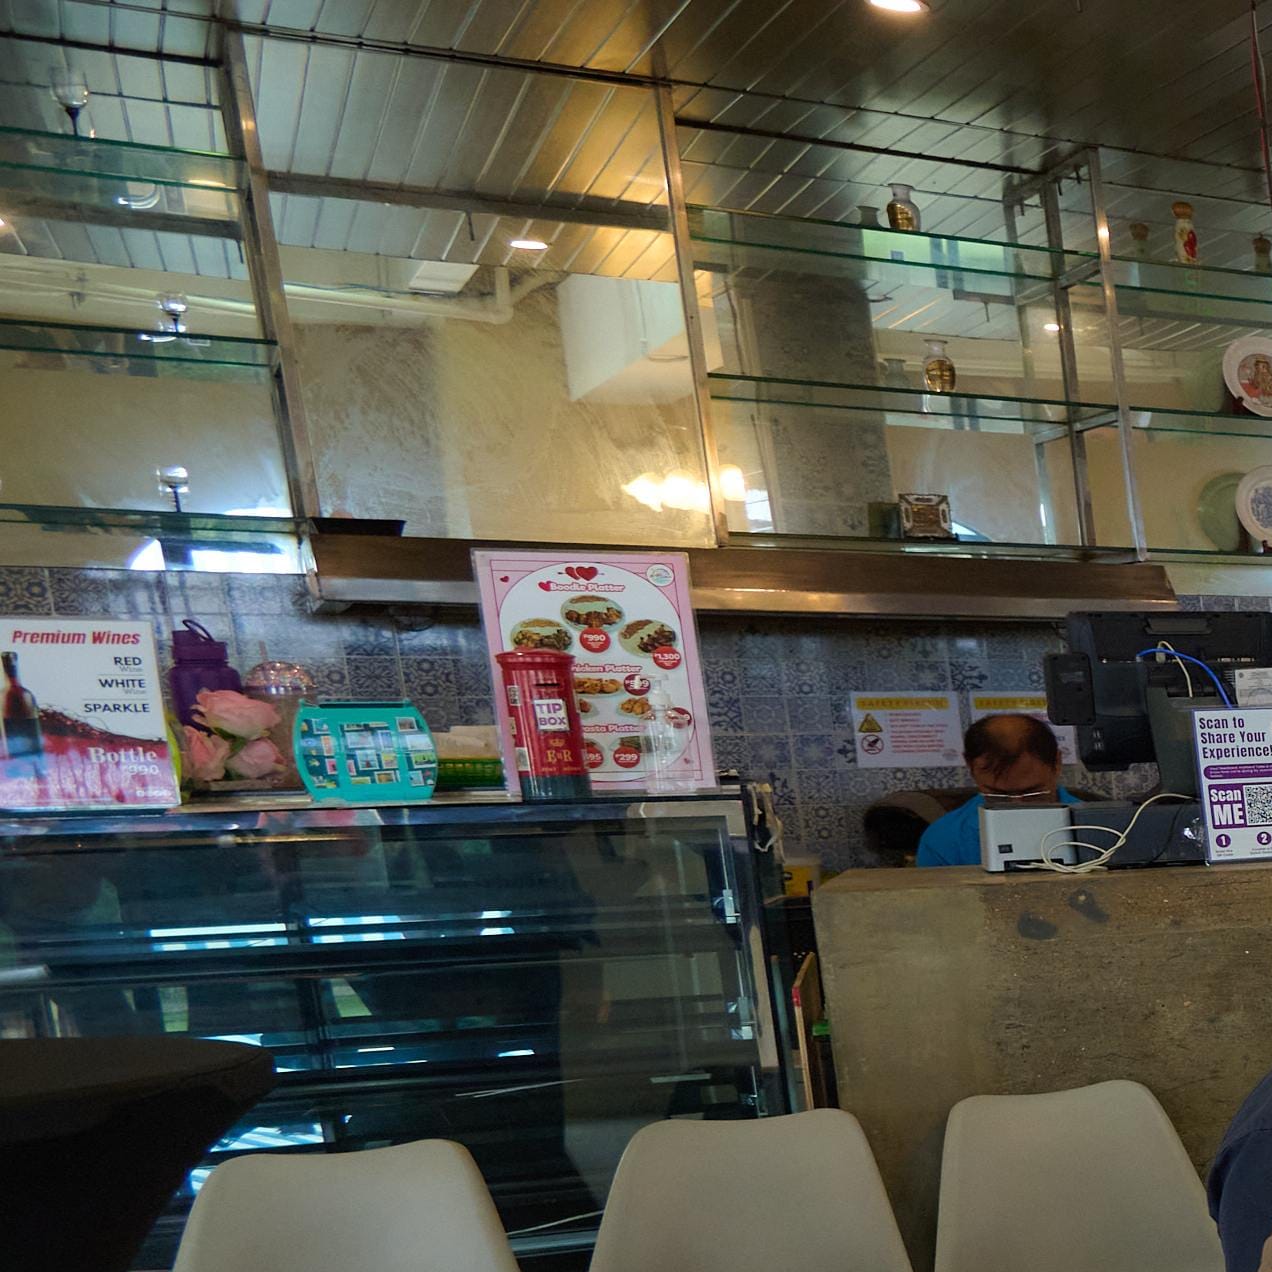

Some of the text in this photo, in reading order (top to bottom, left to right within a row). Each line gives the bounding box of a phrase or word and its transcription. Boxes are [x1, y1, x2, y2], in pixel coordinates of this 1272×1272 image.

[588, 583, 626, 593] Platter
[12, 630, 141, 645] Premium Wines
[114, 656, 142, 667] RED
[99, 678, 147, 688] WHITE
[84, 703, 150, 713] SPARKLE
[536, 702, 563, 714] TIP
[538, 715, 567, 727] BOX
[1199, 717, 1245, 730] Scan to
[1201, 731, 1266, 744] Share Your
[88, 747, 157, 764] Bottle
[1211, 789, 1242, 801] Scan
[1213, 803, 1245, 826] ME
[1261, 834, 1268, 844] 2
